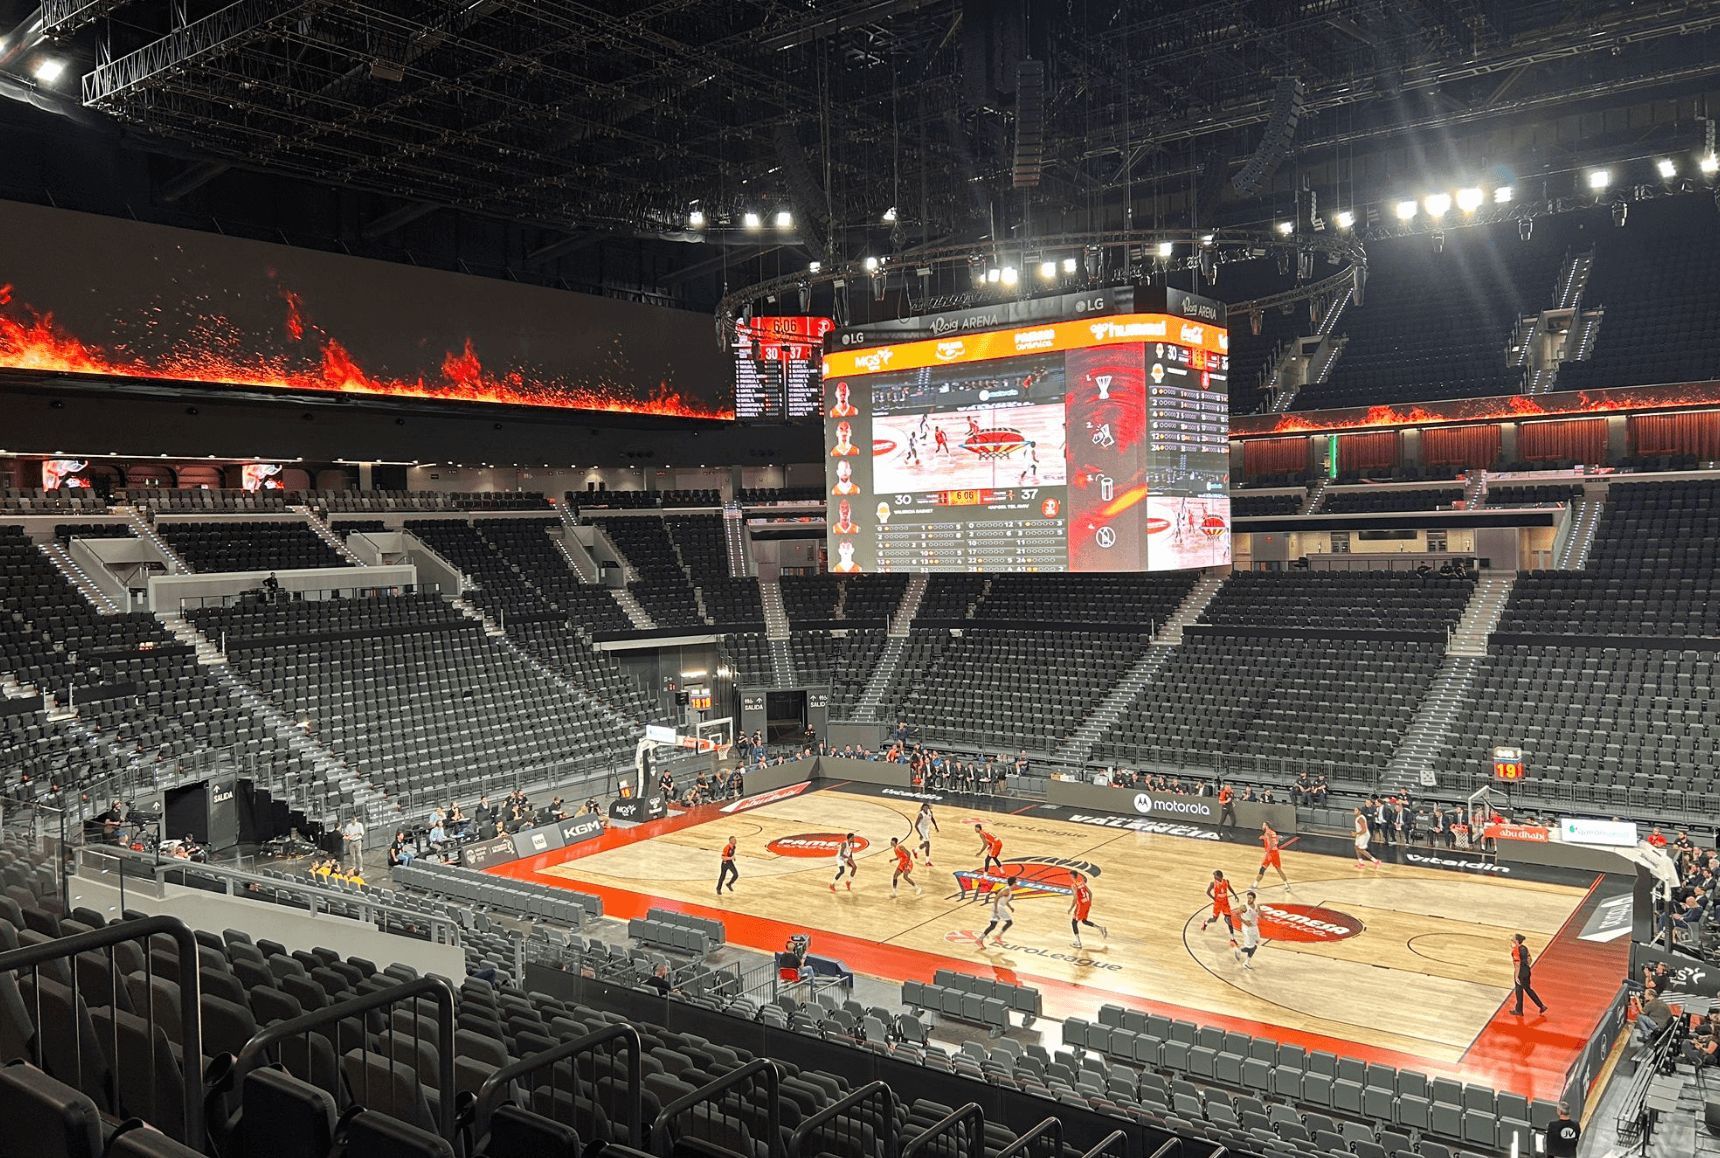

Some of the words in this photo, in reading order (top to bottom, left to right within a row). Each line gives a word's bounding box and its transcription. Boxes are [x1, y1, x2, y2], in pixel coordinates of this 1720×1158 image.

[1088, 298, 1104, 312] LG
[1198, 306, 1217, 320] ARENA
[962, 314, 998, 329] ARENA
[850, 332, 864, 344] LG
[766, 348, 778, 360] 30
[790, 346, 802, 359] 37
[895, 495, 912, 505] 30
[1021, 489, 1038, 500] 37
[1498, 764, 1516, 778] 19
[213, 791, 233, 803] SALIDA
[1154, 800, 1210, 816] motorola
[563, 820, 600, 839] KGM
[1068, 815, 1220, 840] VALENCIA
[1500, 830, 1519, 839] abu
[1519, 831, 1545, 842] dhabi
